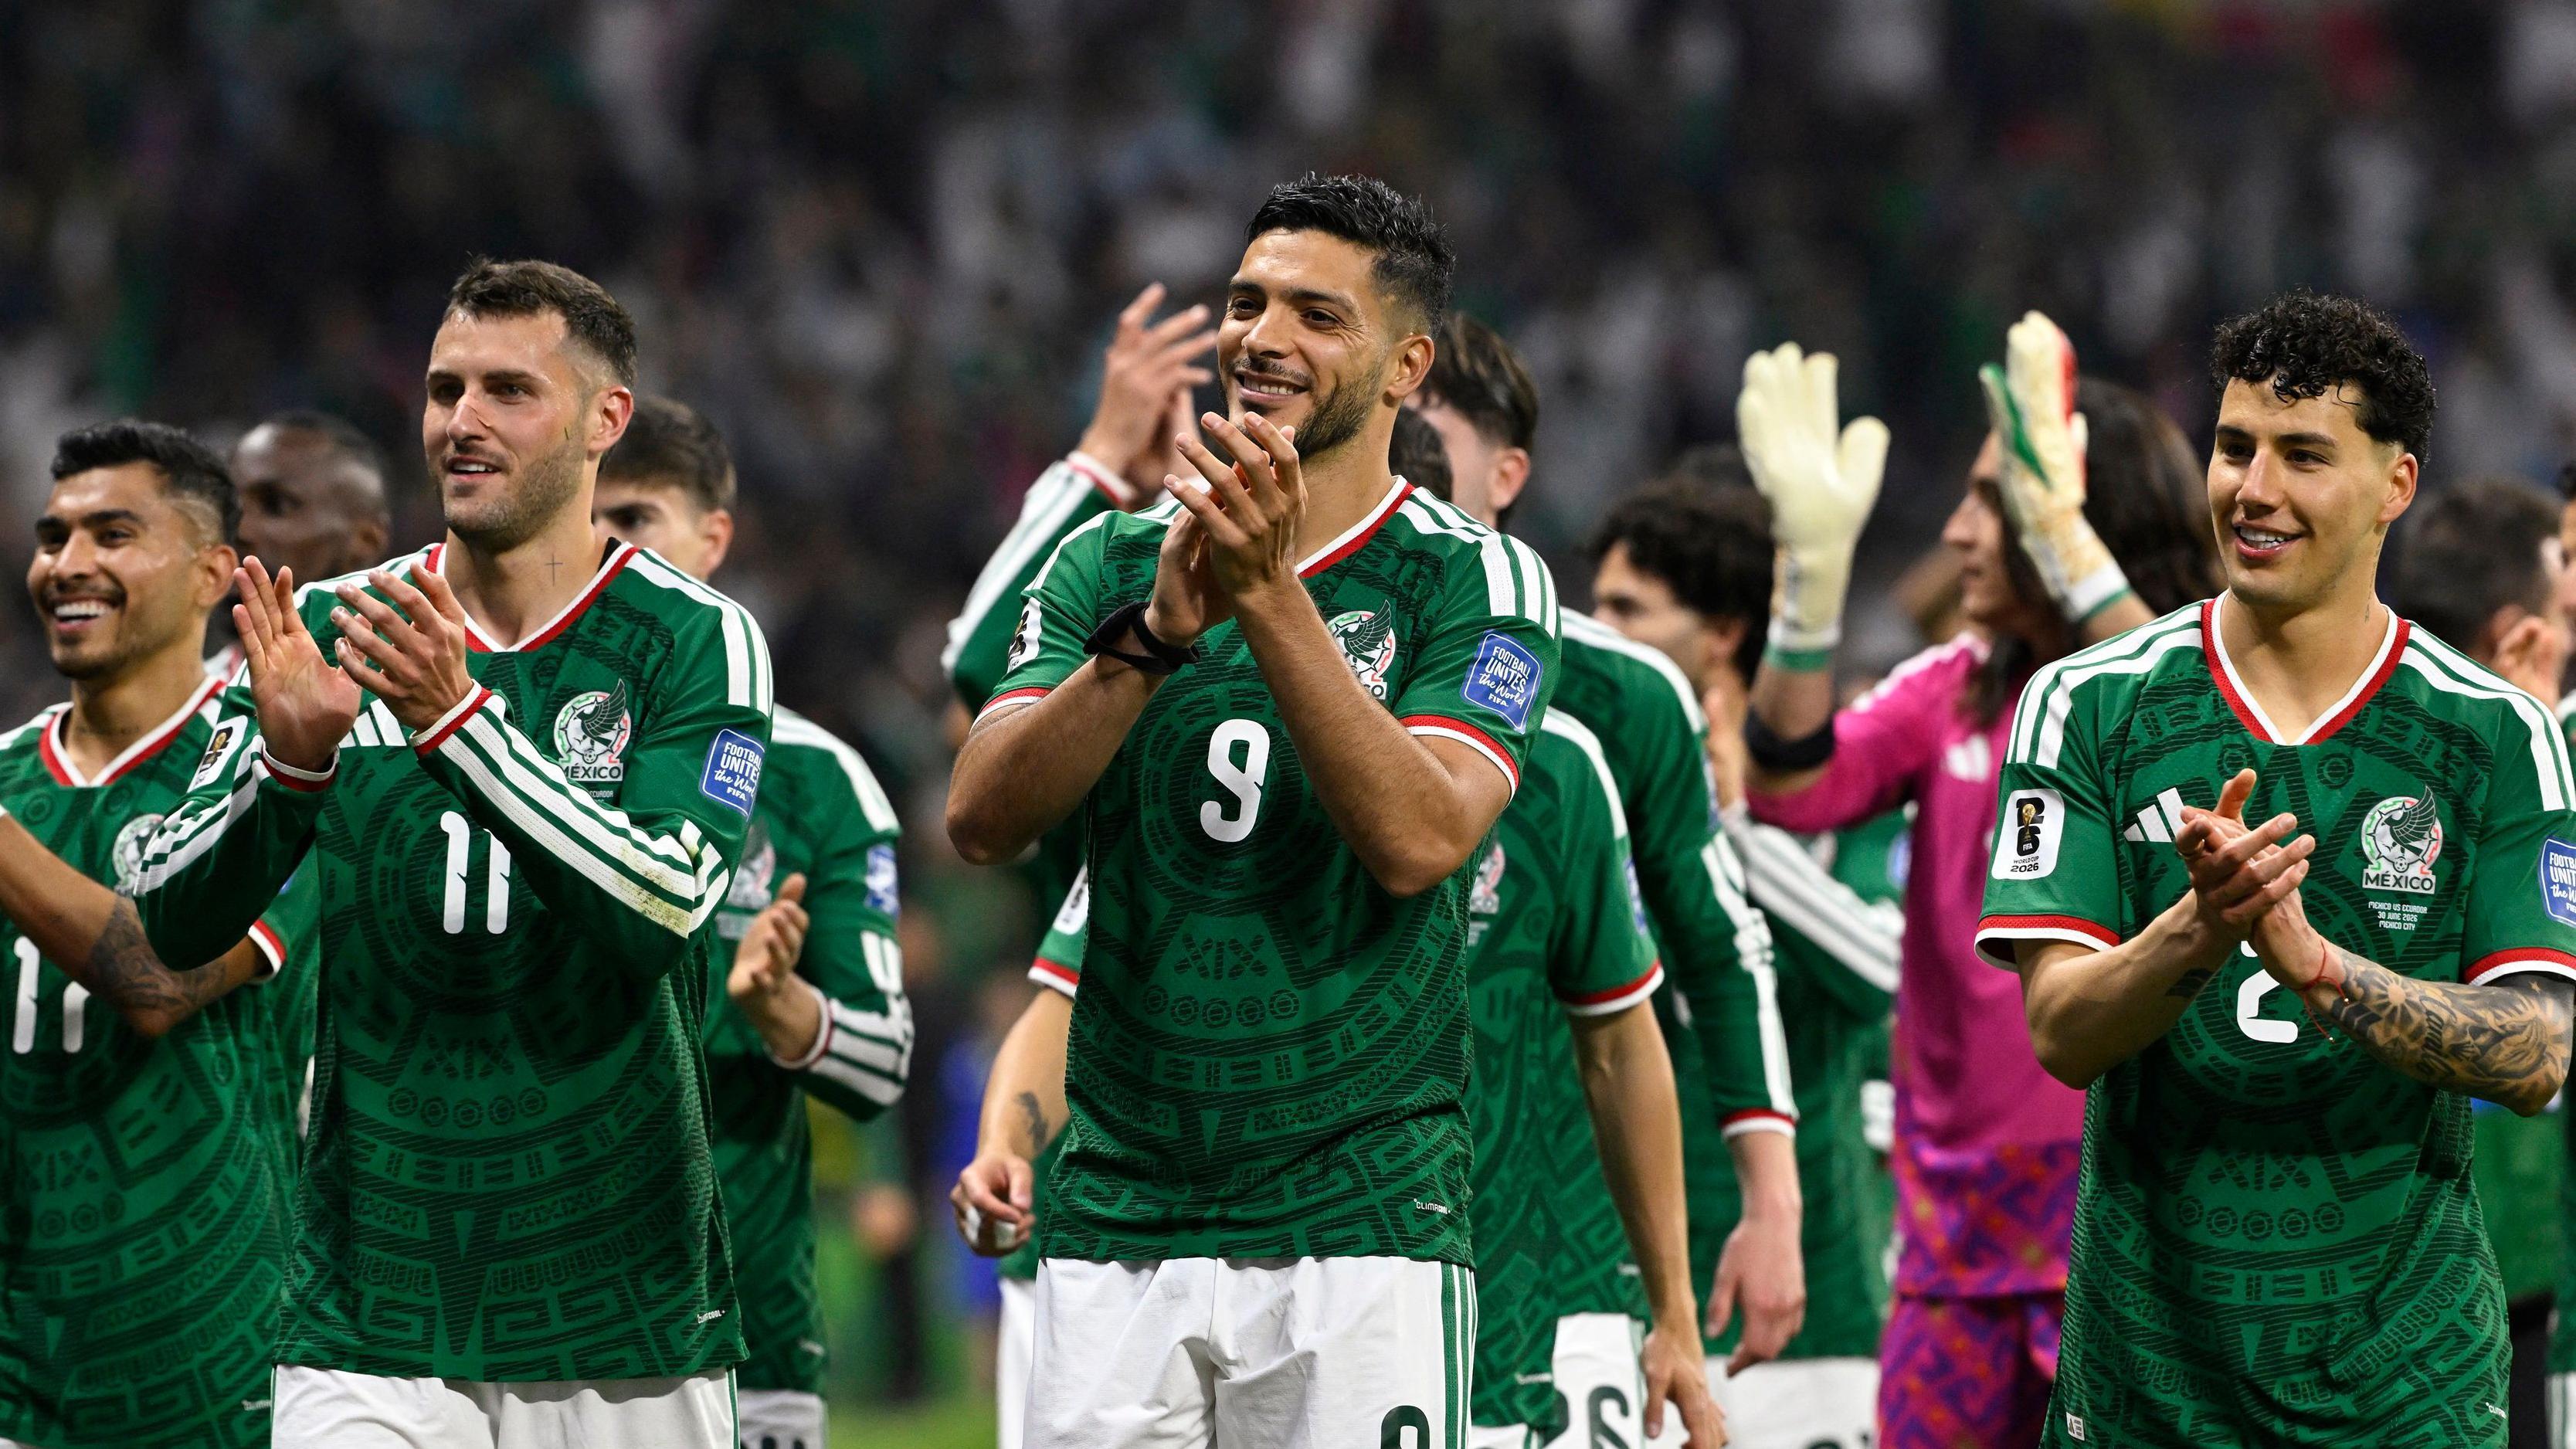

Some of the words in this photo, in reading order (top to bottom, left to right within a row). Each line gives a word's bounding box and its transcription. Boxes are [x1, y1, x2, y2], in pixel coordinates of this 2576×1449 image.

[1492, 646, 1531, 680] FOOTBALL
[1485, 657, 1526, 694] UNITES
[1478, 674, 1496, 688] the
[1495, 681, 1526, 709] World
[1488, 693, 1509, 708] FIFA
[714, 769, 733, 783] the
[1200, 718, 1271, 843] 9
[727, 787, 747, 801] FIFA
[2010, 862, 2039, 873] 2026
[2549, 852, 2576, 869] FOOTB
[440, 811, 511, 935] 11
[2364, 870, 2434, 891] MÉXICO
[2550, 884, 2568, 898] the
[2368, 901, 2391, 911] MEXICO
[2401, 904, 2428, 914] ECUADOR
[2377, 911, 2386, 919] 30
[2388, 912, 2401, 921] JUNE
[2402, 914, 2418, 922] 2026
[2379, 921, 2402, 930] MEXICO
